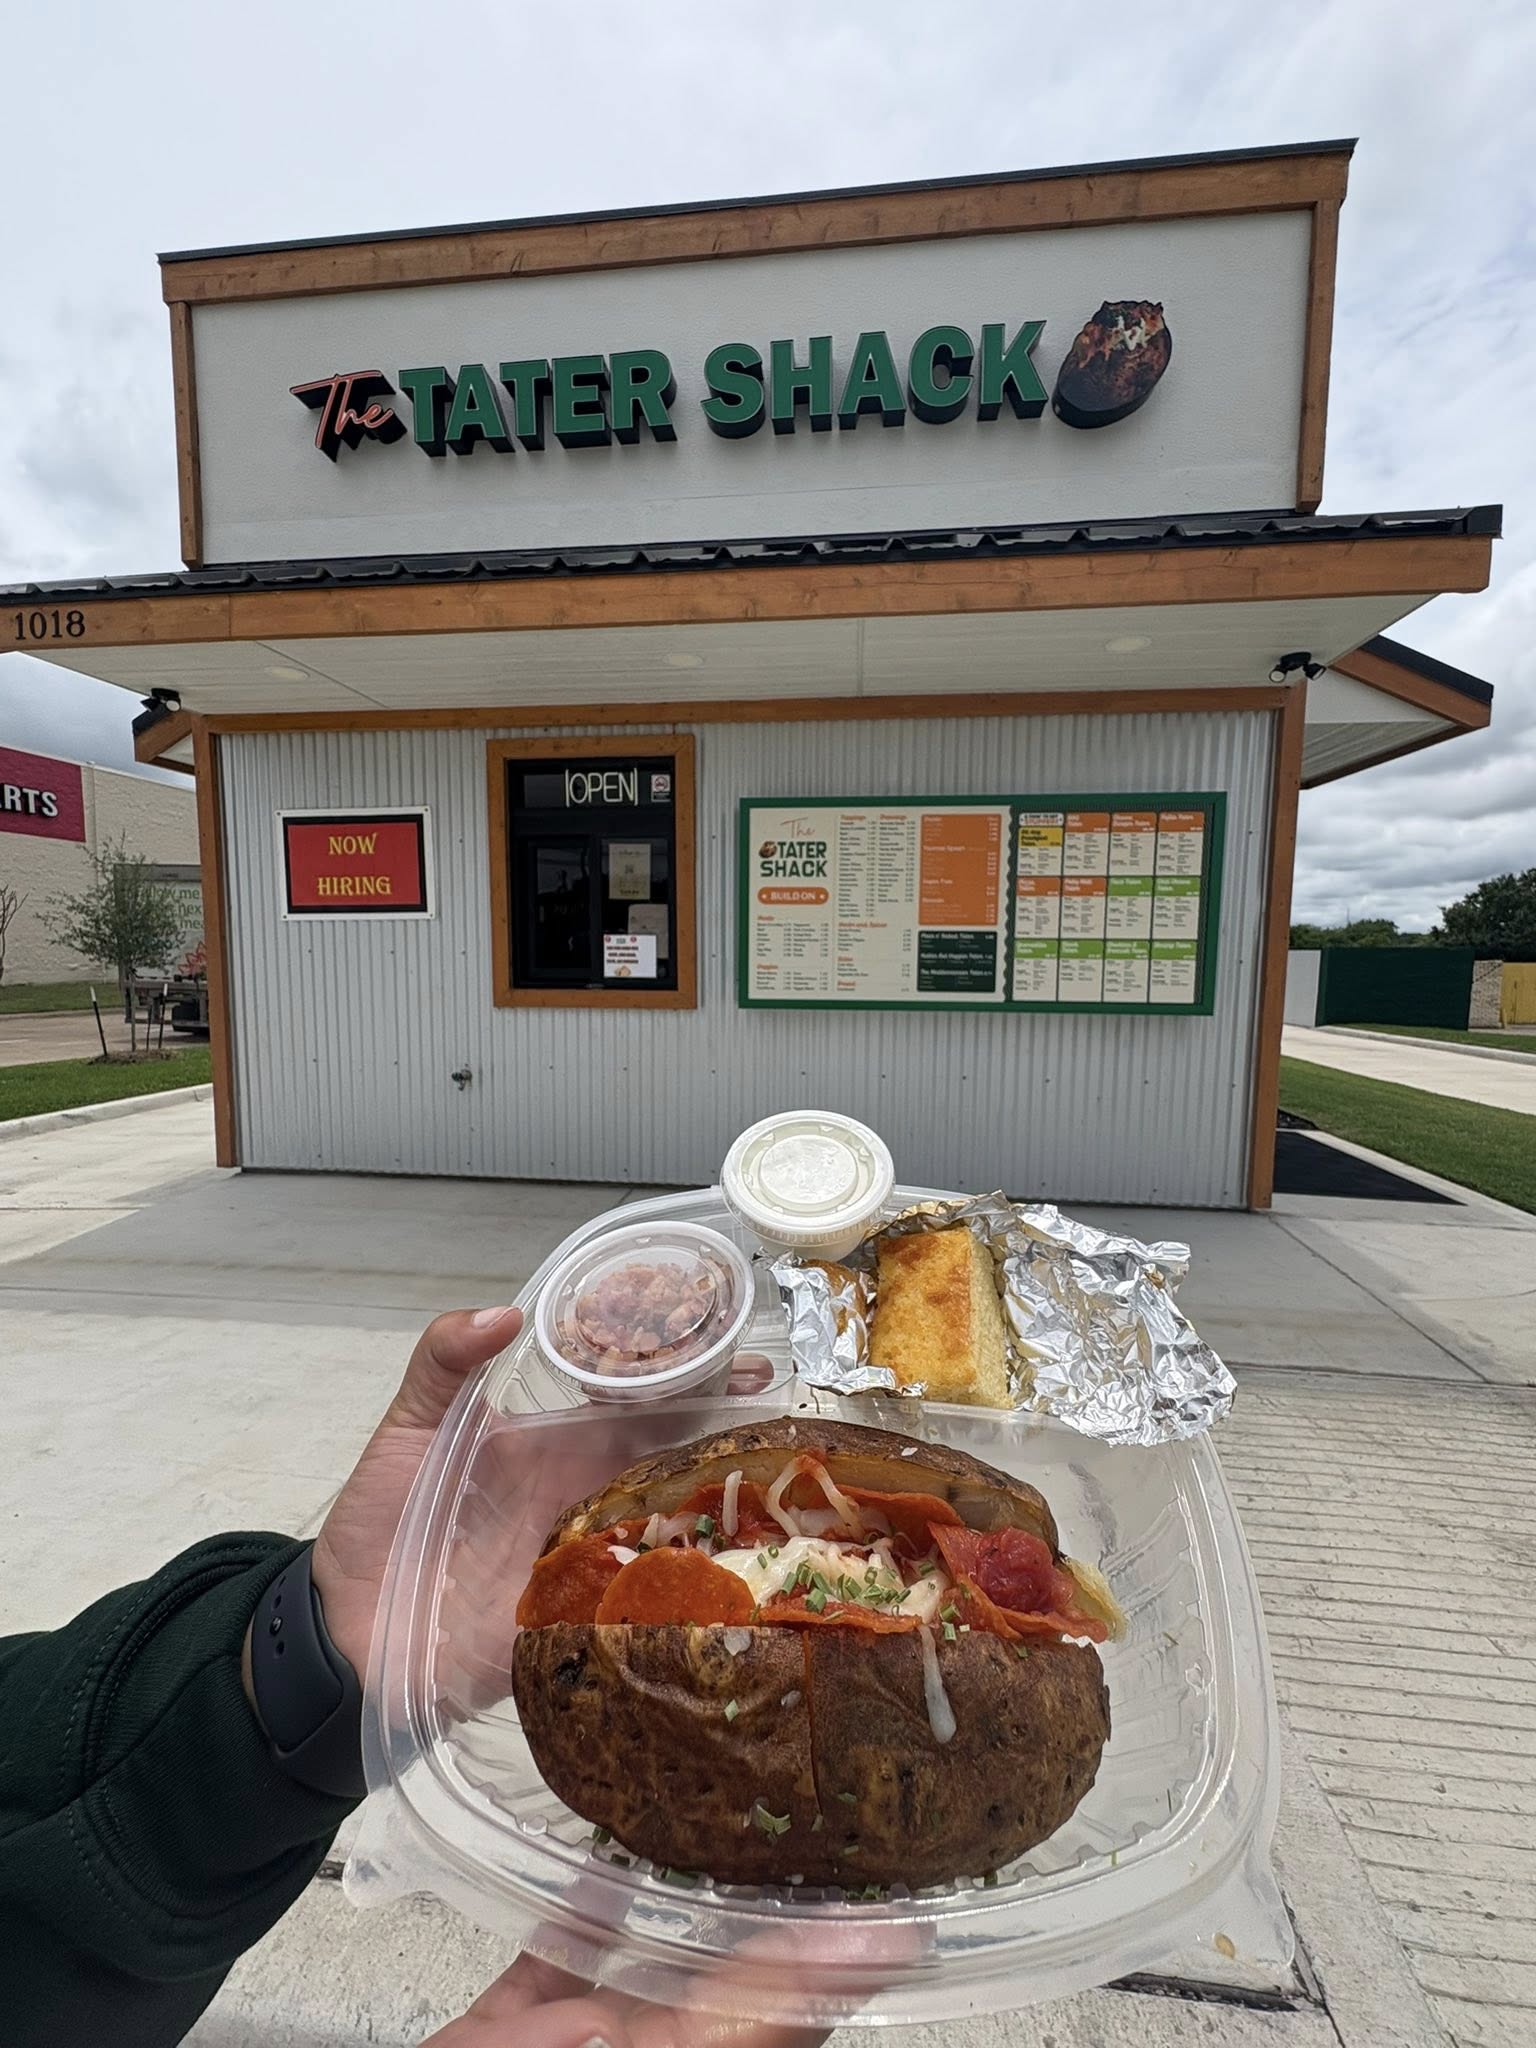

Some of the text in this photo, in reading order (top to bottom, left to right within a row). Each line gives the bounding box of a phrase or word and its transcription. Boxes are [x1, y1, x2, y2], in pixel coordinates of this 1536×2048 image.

[289, 320, 1048, 457] The TATER SHACK
[15, 609, 86, 640] 1018
[569, 771, 635, 804] OPEN
[0, 783, 58, 817] RTS
[780, 816, 816, 839] The
[328, 832, 377, 855] NOW
[777, 841, 827, 858] TATER
[760, 860, 828, 877] SHACK
[317, 876, 392, 897] HIRING
[770, 891, 817, 901] BUILD ON
